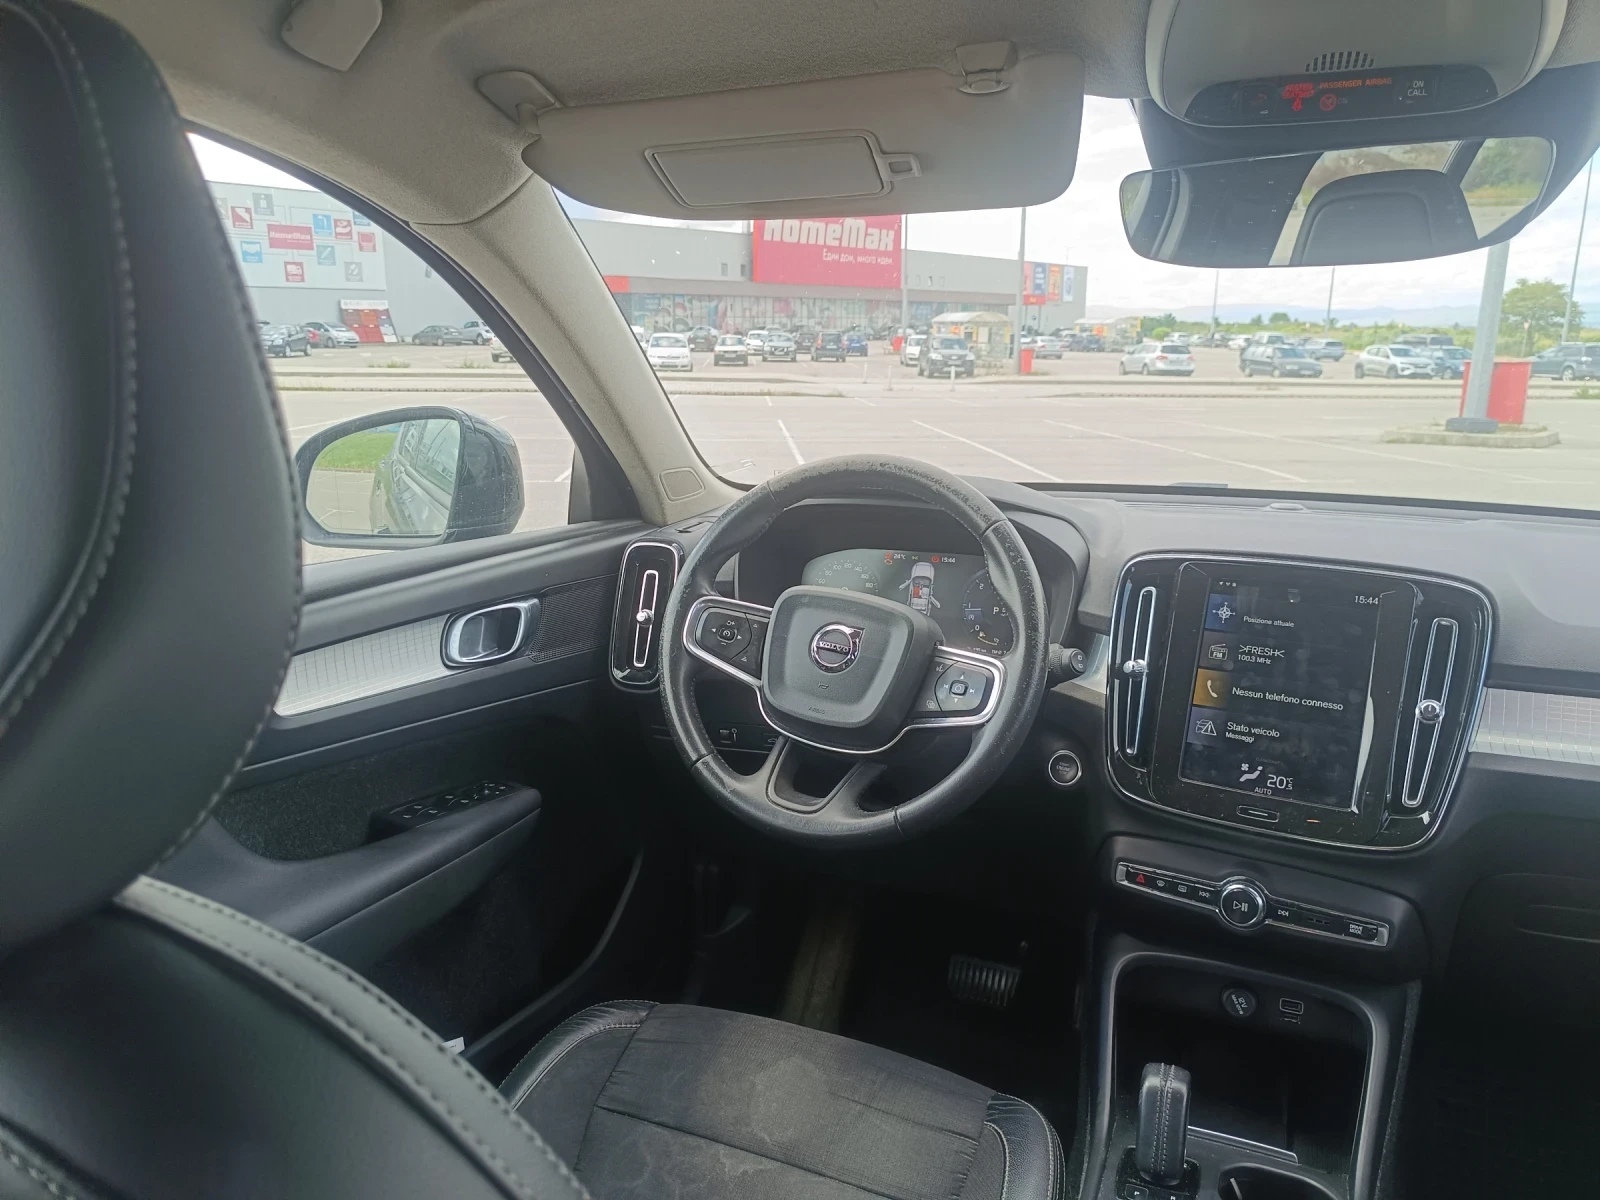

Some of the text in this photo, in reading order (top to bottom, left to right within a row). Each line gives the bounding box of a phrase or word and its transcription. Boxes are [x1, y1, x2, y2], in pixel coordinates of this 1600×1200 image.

[1320, 77, 1392, 89] PASSENGER AIRBAG
[1413, 80, 1425, 88] ON
[763, 217, 895, 251] HomeMax
[1354, 595, 1380, 605] 15:44
[1243, 616, 1272, 625] Posizione
[819, 641, 849, 652] VOLVO
[1232, 687, 1344, 711] Nessun telefono connesso
[1226, 722, 1280, 738] Stato veicolo
[1226, 732, 1255, 743] Messaggi
[1254, 787, 1272, 795] AUTO
